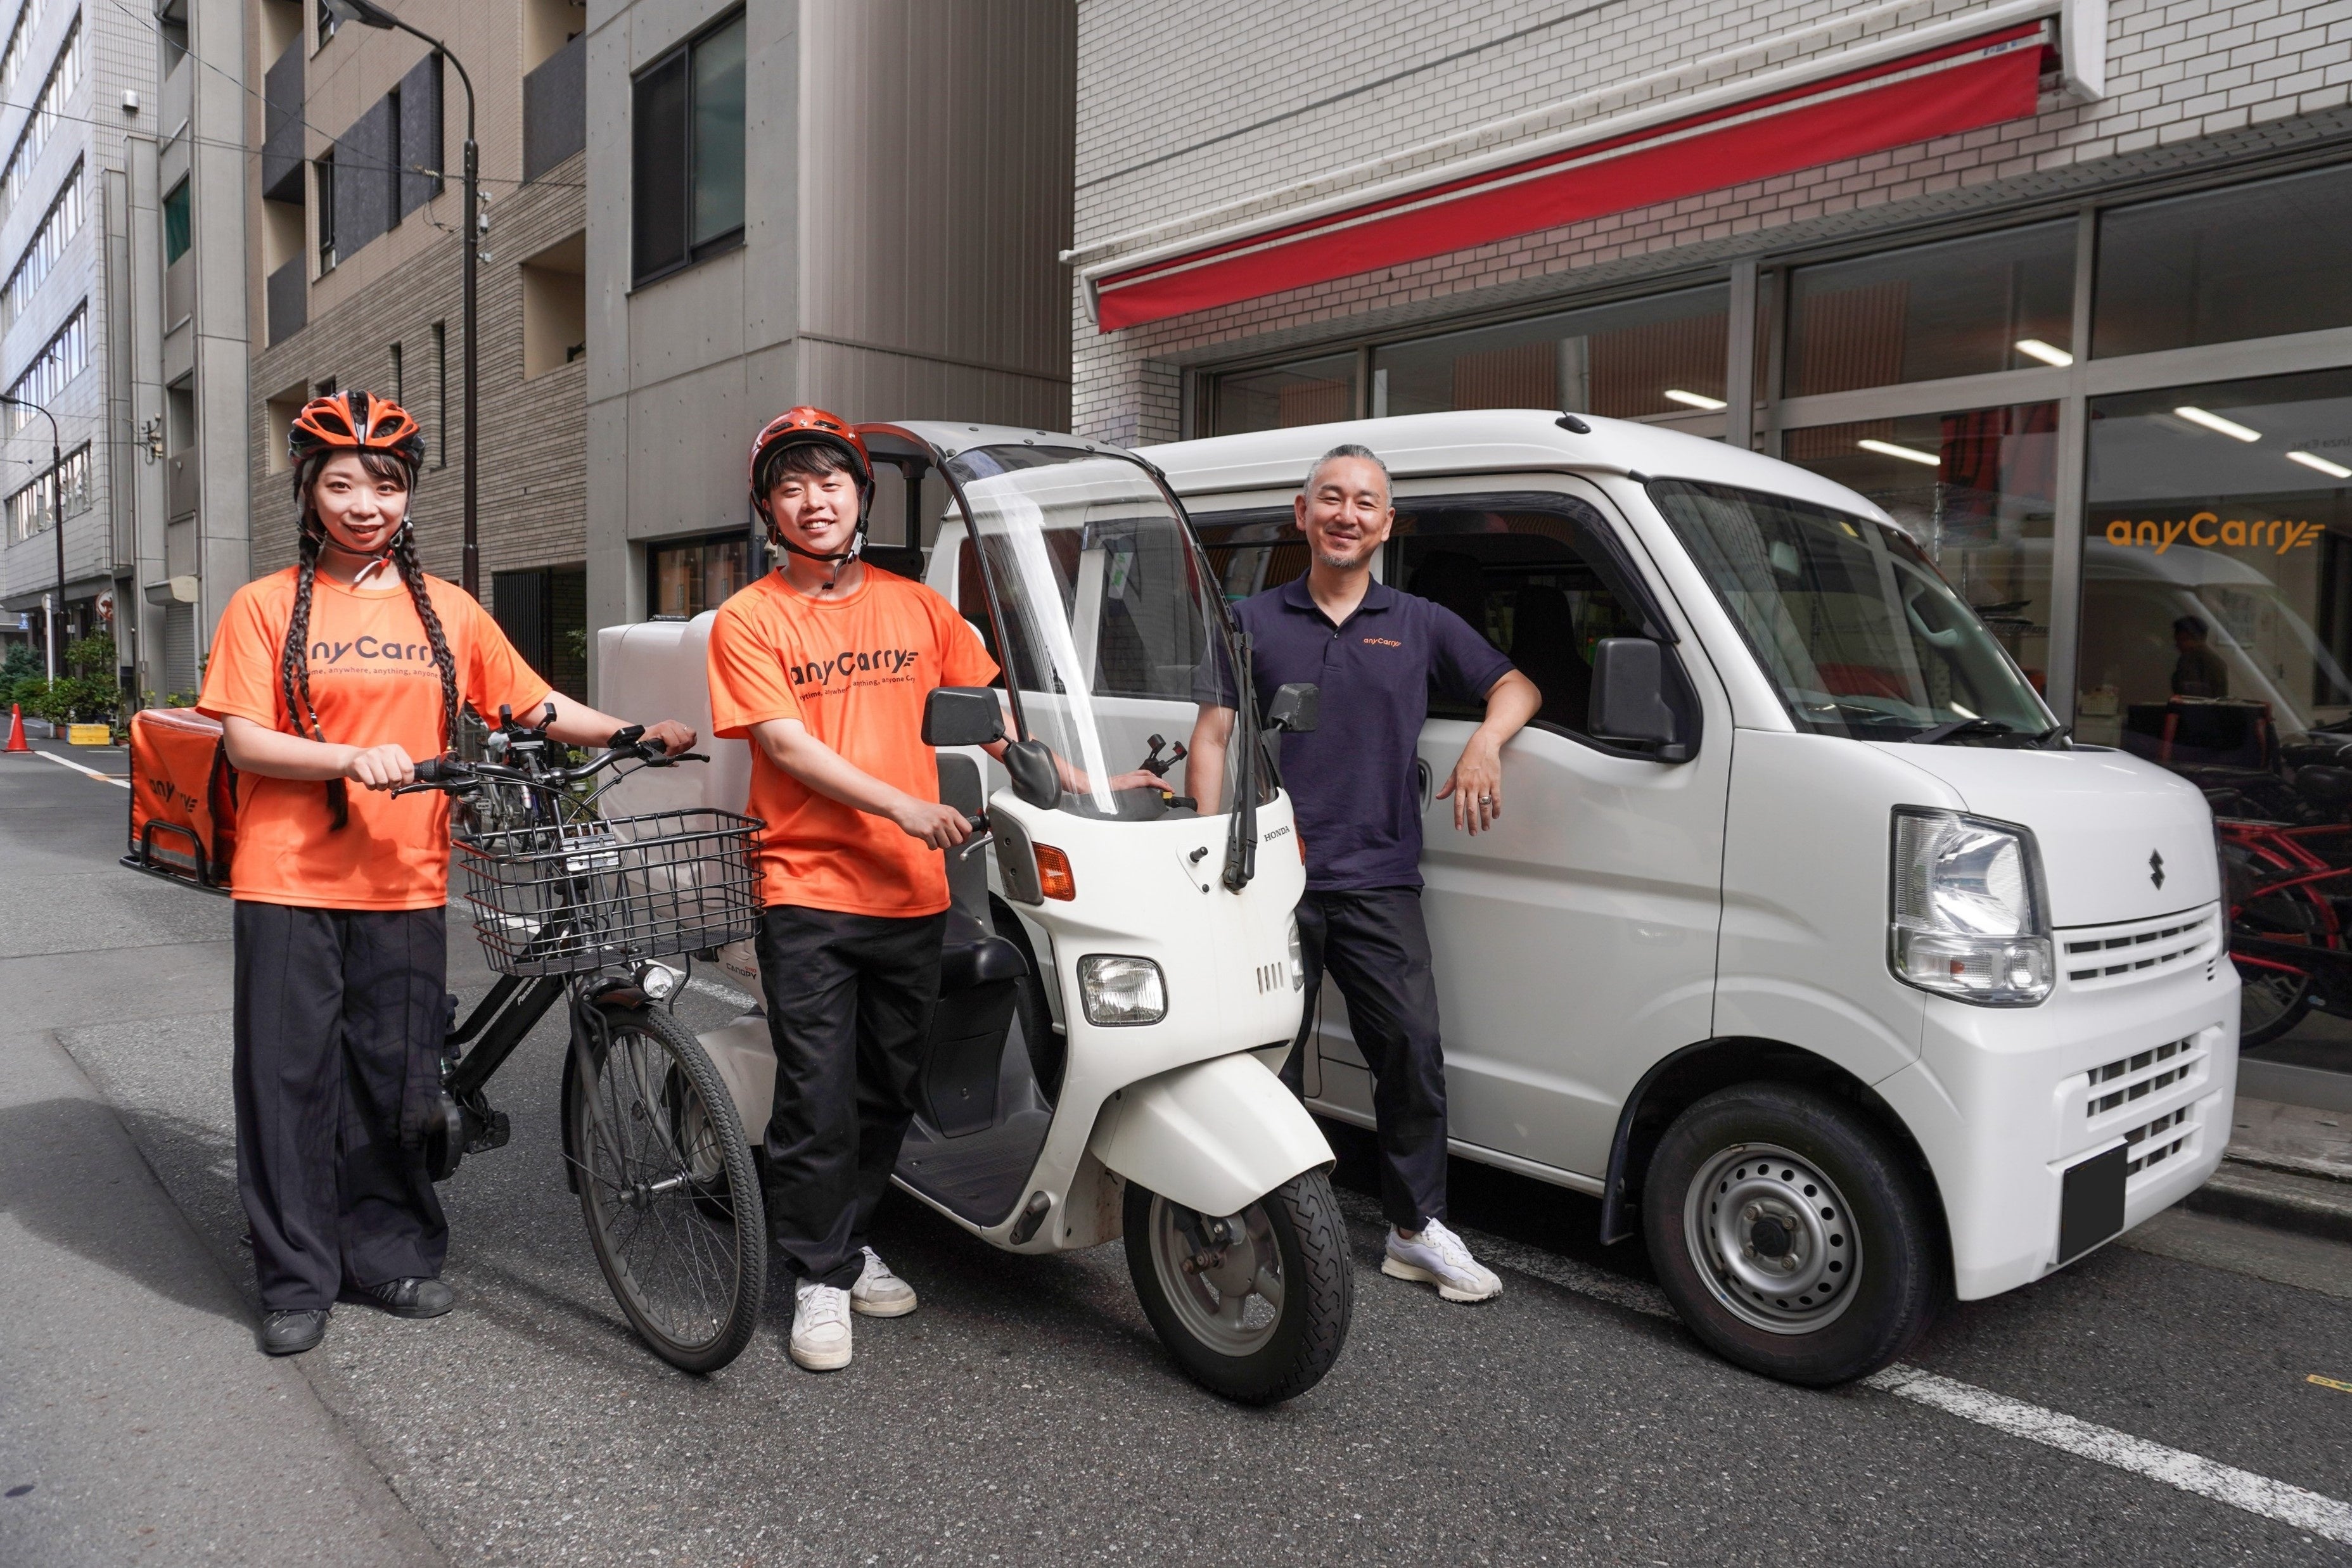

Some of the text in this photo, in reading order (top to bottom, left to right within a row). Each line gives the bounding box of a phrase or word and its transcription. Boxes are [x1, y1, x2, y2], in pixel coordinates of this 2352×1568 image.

[2106, 512, 2310, 555] anyCarry
[311, 635, 438, 668] nyCarr
[1363, 638, 1399, 647] anyCarry
[373, 668, 411, 676] anything,
[413, 670, 438, 679] anyone
[790, 649, 909, 686] anyCarry
[1263, 825, 1290, 842] HONDA
[726, 963, 757, 979] CANOPY
[517, 976, 543, 1006] Panason
